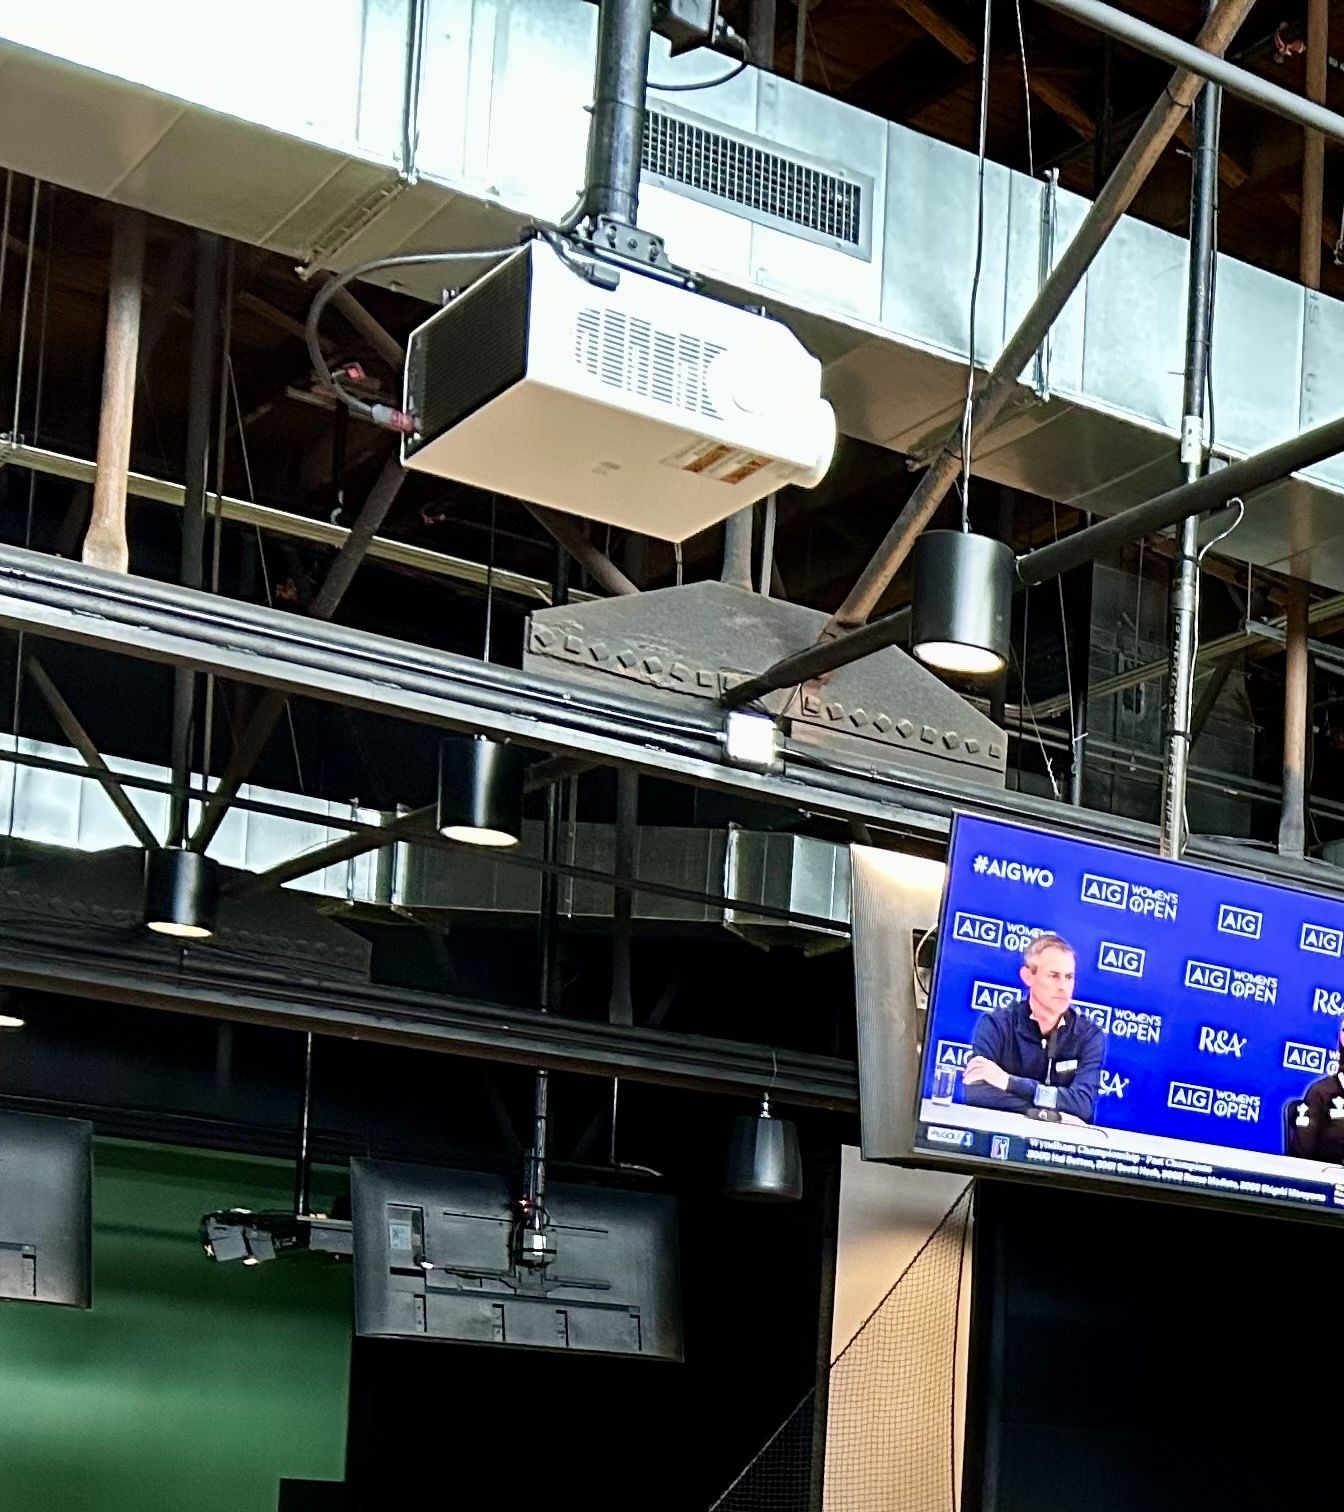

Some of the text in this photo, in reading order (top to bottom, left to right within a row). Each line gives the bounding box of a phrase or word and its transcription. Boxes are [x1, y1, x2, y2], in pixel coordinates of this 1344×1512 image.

[973, 854, 1054, 888] #AIGWO
[1086, 880, 1122, 902] AIG
[1131, 884, 1179, 904] WOMEN'S
[1129, 895, 1178, 921] OPEN
[959, 918, 996, 940] AIG
[1221, 910, 1257, 933] AIG
[1004, 933, 1032, 952] OP
[1305, 929, 1338, 951] AIG
[1103, 947, 1139, 970] AIG
[1188, 966, 1225, 988] AIG
[1233, 969, 1278, 989] WOMEN'S
[979, 987, 1014, 1007] AIG
[1231, 979, 1278, 1005] OPEN
[1114, 1007, 1162, 1026] WOMEN'S
[1112, 1019, 1161, 1043] OPEN
[1199, 1026, 1248, 1058] R&A
[1288, 1047, 1322, 1068] AIG
[1172, 1085, 1208, 1108] AIG
[1215, 1089, 1261, 1108] WOMEN'S
[1213, 1100, 1260, 1124] OPEN
